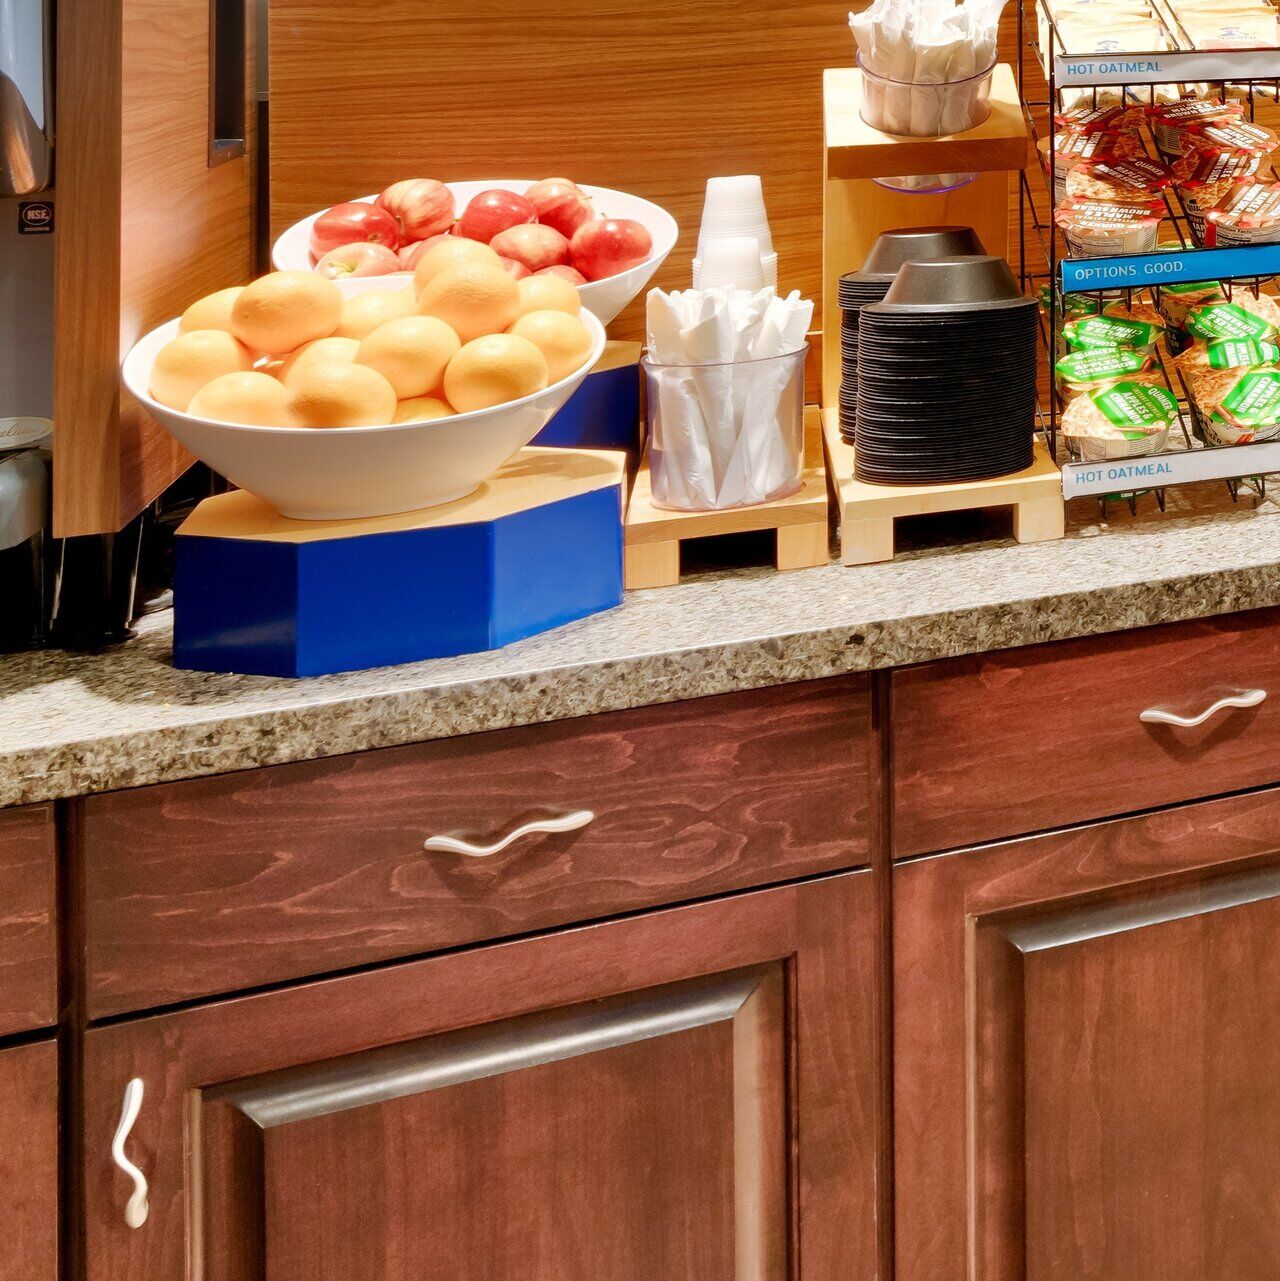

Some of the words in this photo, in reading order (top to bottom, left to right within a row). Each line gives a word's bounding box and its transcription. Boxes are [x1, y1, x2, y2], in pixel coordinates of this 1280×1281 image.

[1067, 63, 1094, 75] HOT
[1099, 61, 1163, 74] OATMEAL
[1075, 264, 1140, 281] OPTIONS.
[1076, 470, 1103, 484] HOT
[1107, 462, 1173, 481] OATMEAL
